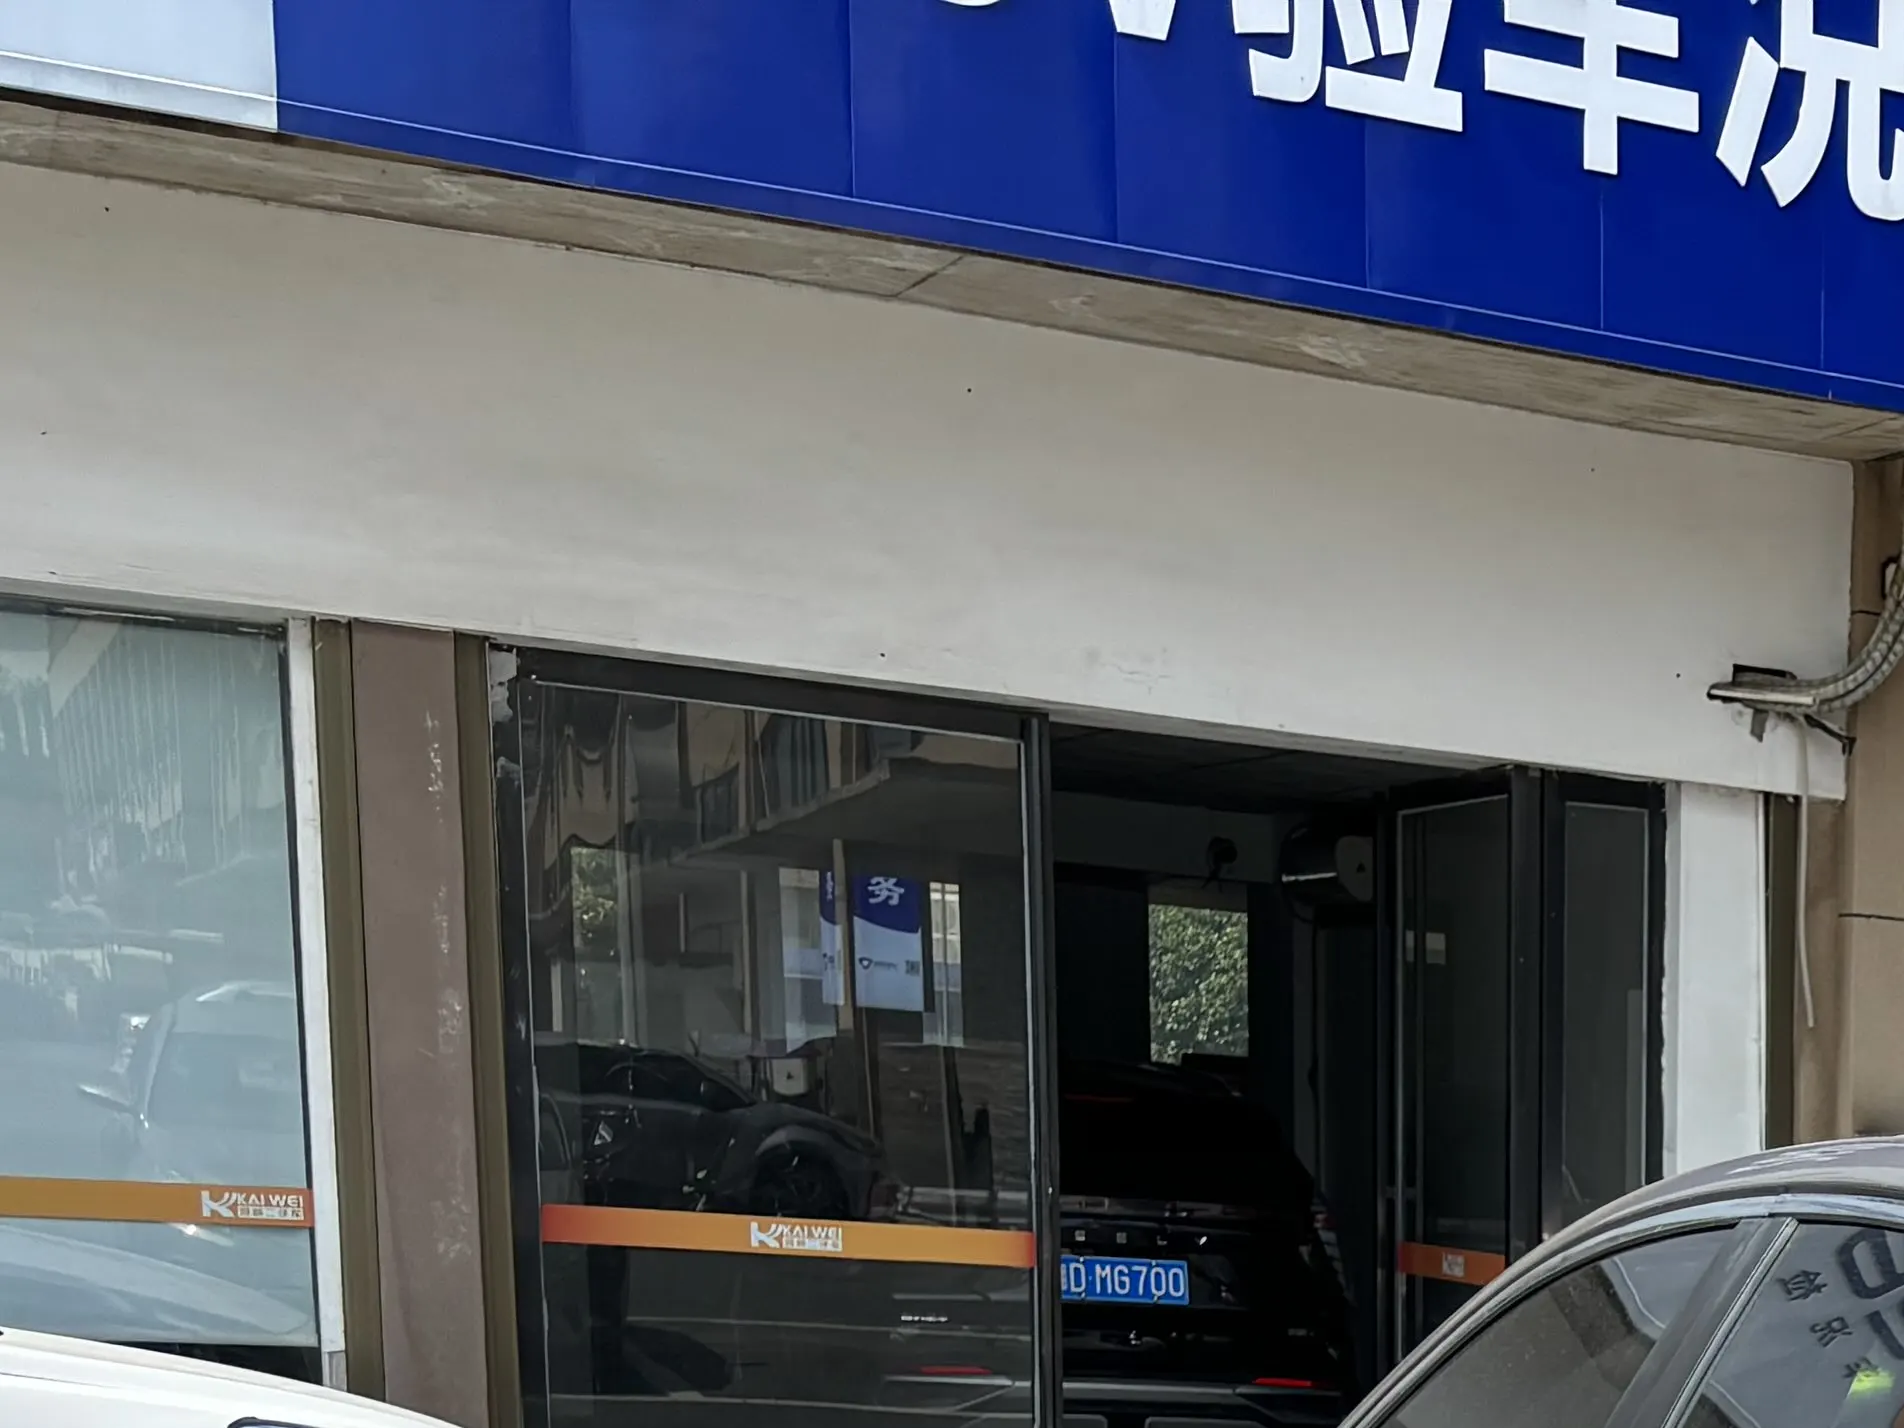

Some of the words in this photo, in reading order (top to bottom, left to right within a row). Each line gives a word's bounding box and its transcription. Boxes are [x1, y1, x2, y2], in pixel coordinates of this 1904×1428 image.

[867, 876, 905, 906] 务
[236, 1192, 265, 1206] KAI
[268, 1194, 304, 1208] WEI
